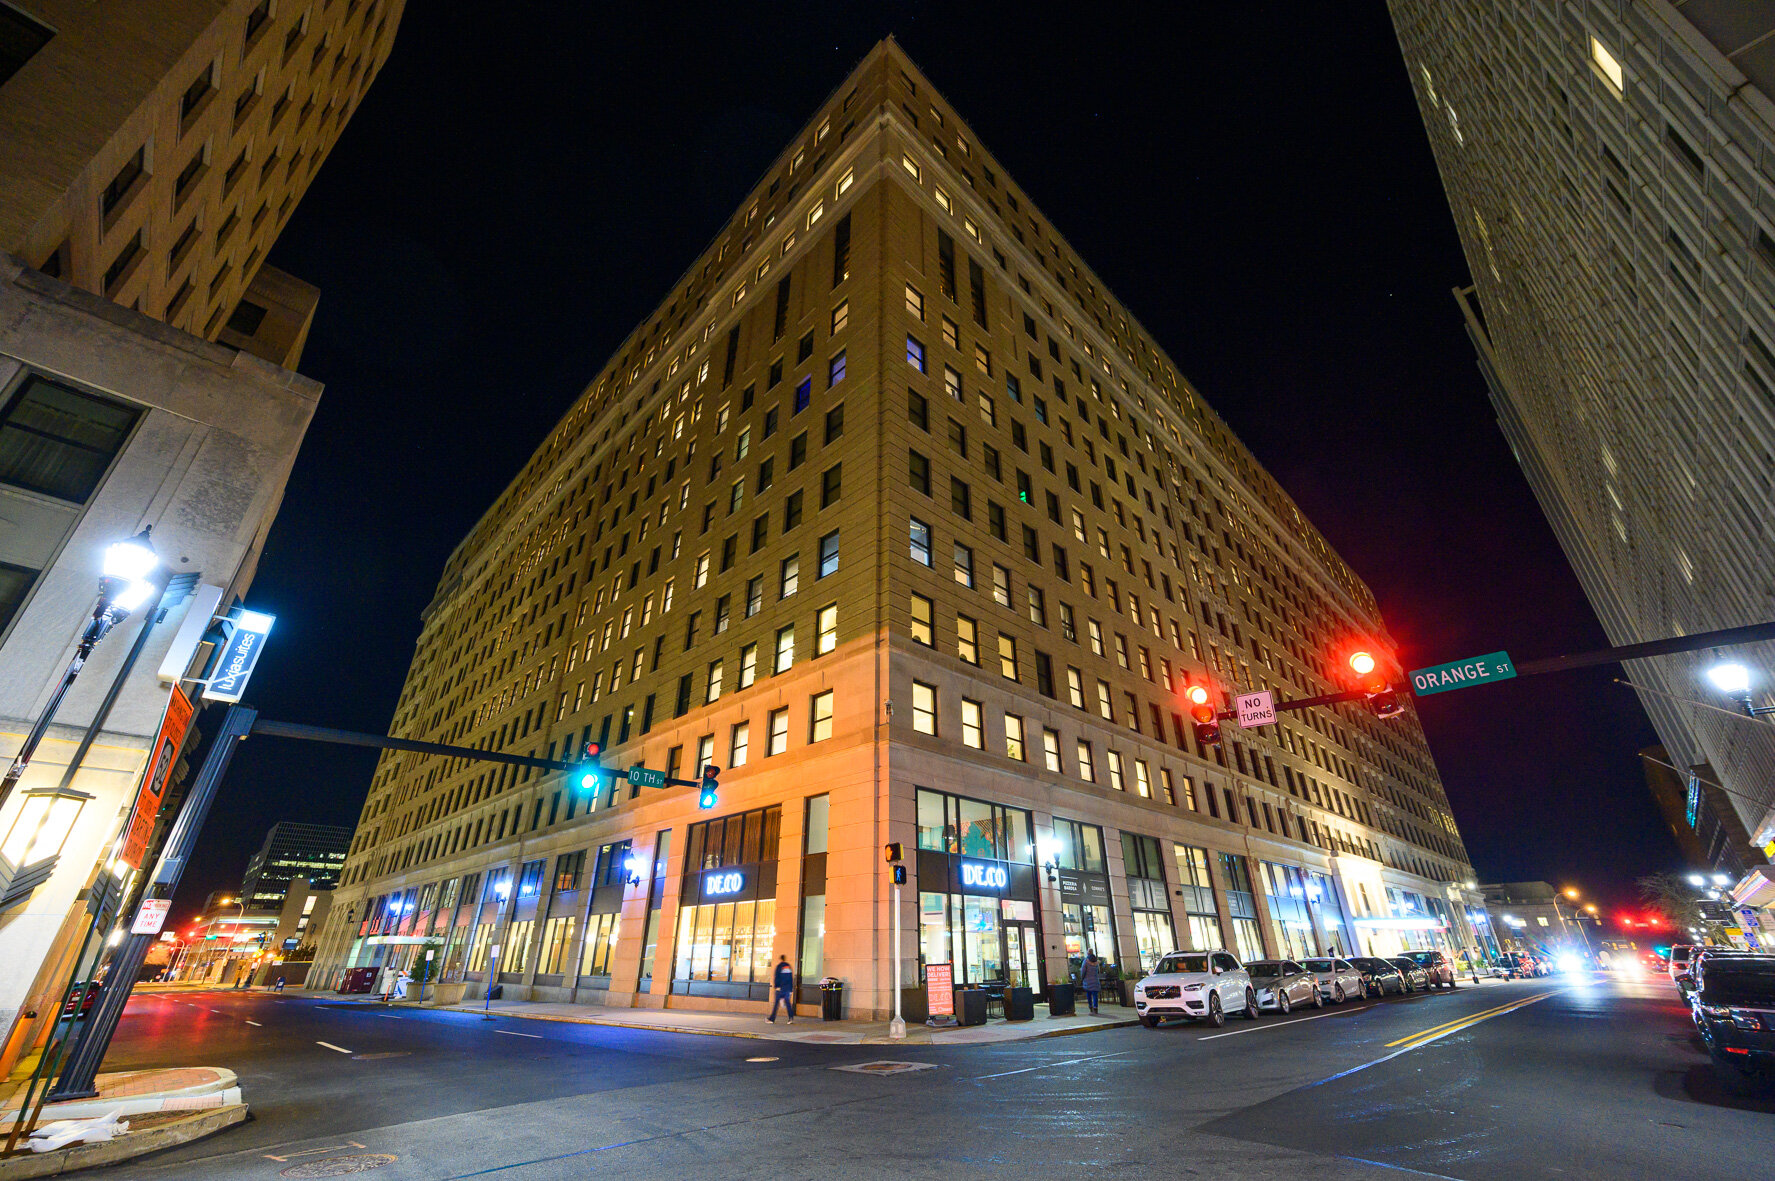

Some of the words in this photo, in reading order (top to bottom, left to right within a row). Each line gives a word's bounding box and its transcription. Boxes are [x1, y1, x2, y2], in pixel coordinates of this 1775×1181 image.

[217, 632, 255, 690] luxiasuites
[1415, 662, 1490, 690] ORANGE
[1496, 664, 1509, 673] ST
[1244, 698, 1261, 708] NO
[1241, 709, 1272, 722] TURNS
[630, 770, 640, 781] 10
[644, 772, 656, 784] TH
[706, 873, 742, 894] DE.CO
[962, 864, 1007, 888] DE.CO
